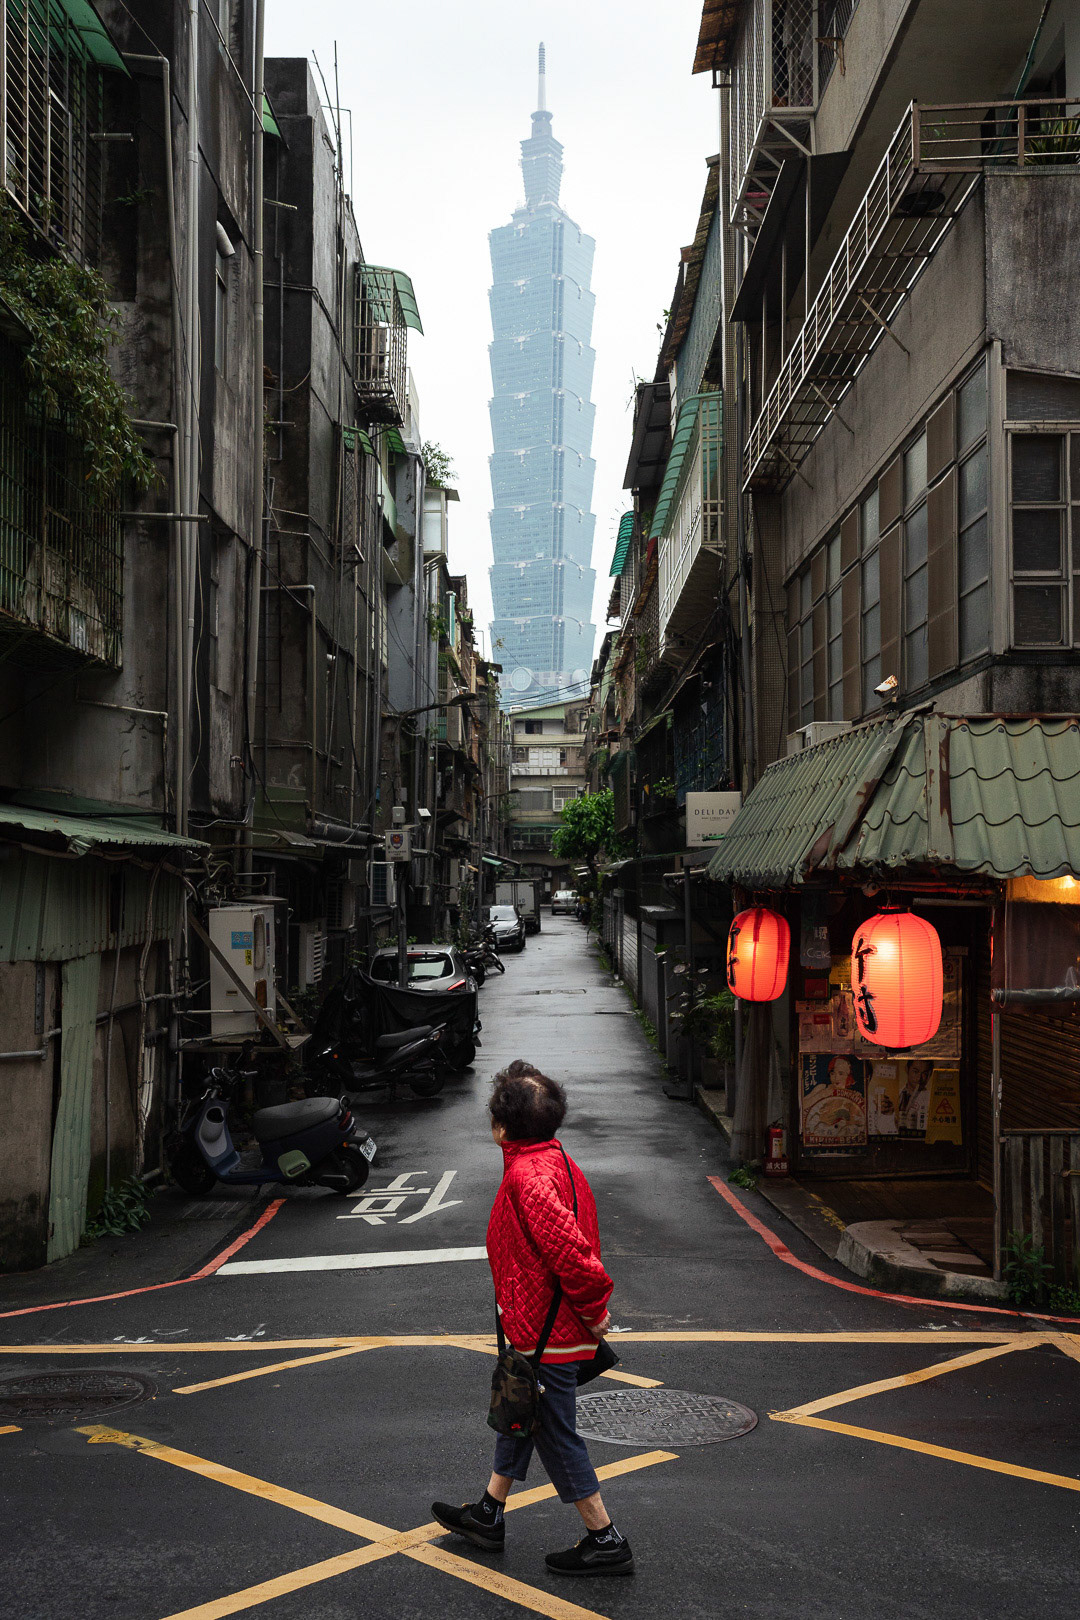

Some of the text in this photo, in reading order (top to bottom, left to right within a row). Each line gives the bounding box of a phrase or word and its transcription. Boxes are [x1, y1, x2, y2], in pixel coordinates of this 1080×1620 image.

[932, 1116, 957, 1124] 小心地滑
[766, 1162, 788, 1170] 滅火器
[336, 1170, 463, 1225] 停
